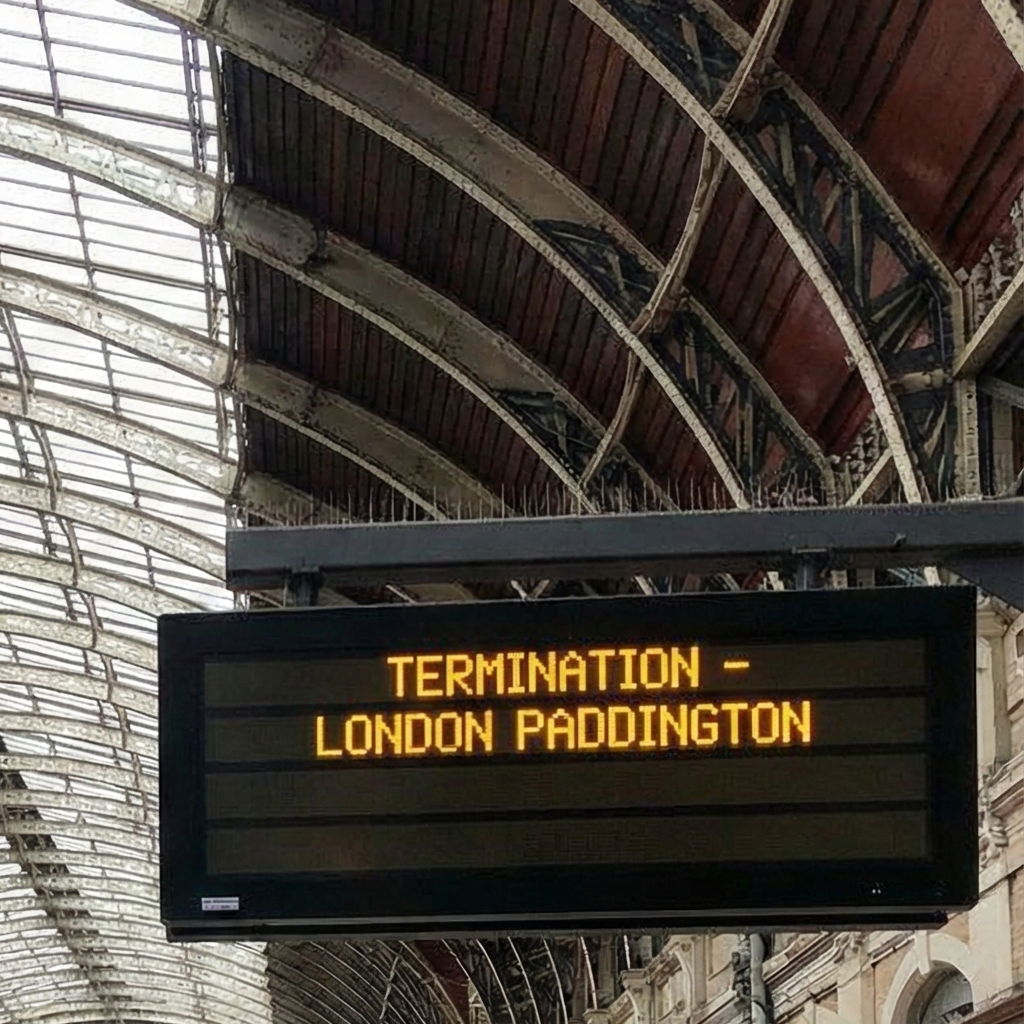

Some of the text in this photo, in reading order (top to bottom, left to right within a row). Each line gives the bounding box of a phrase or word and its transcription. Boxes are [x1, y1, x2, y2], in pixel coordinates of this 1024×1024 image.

[386, 646, 700, 698] TERMINATION
[316, 700, 811, 757] LONDON PADDINGTON
